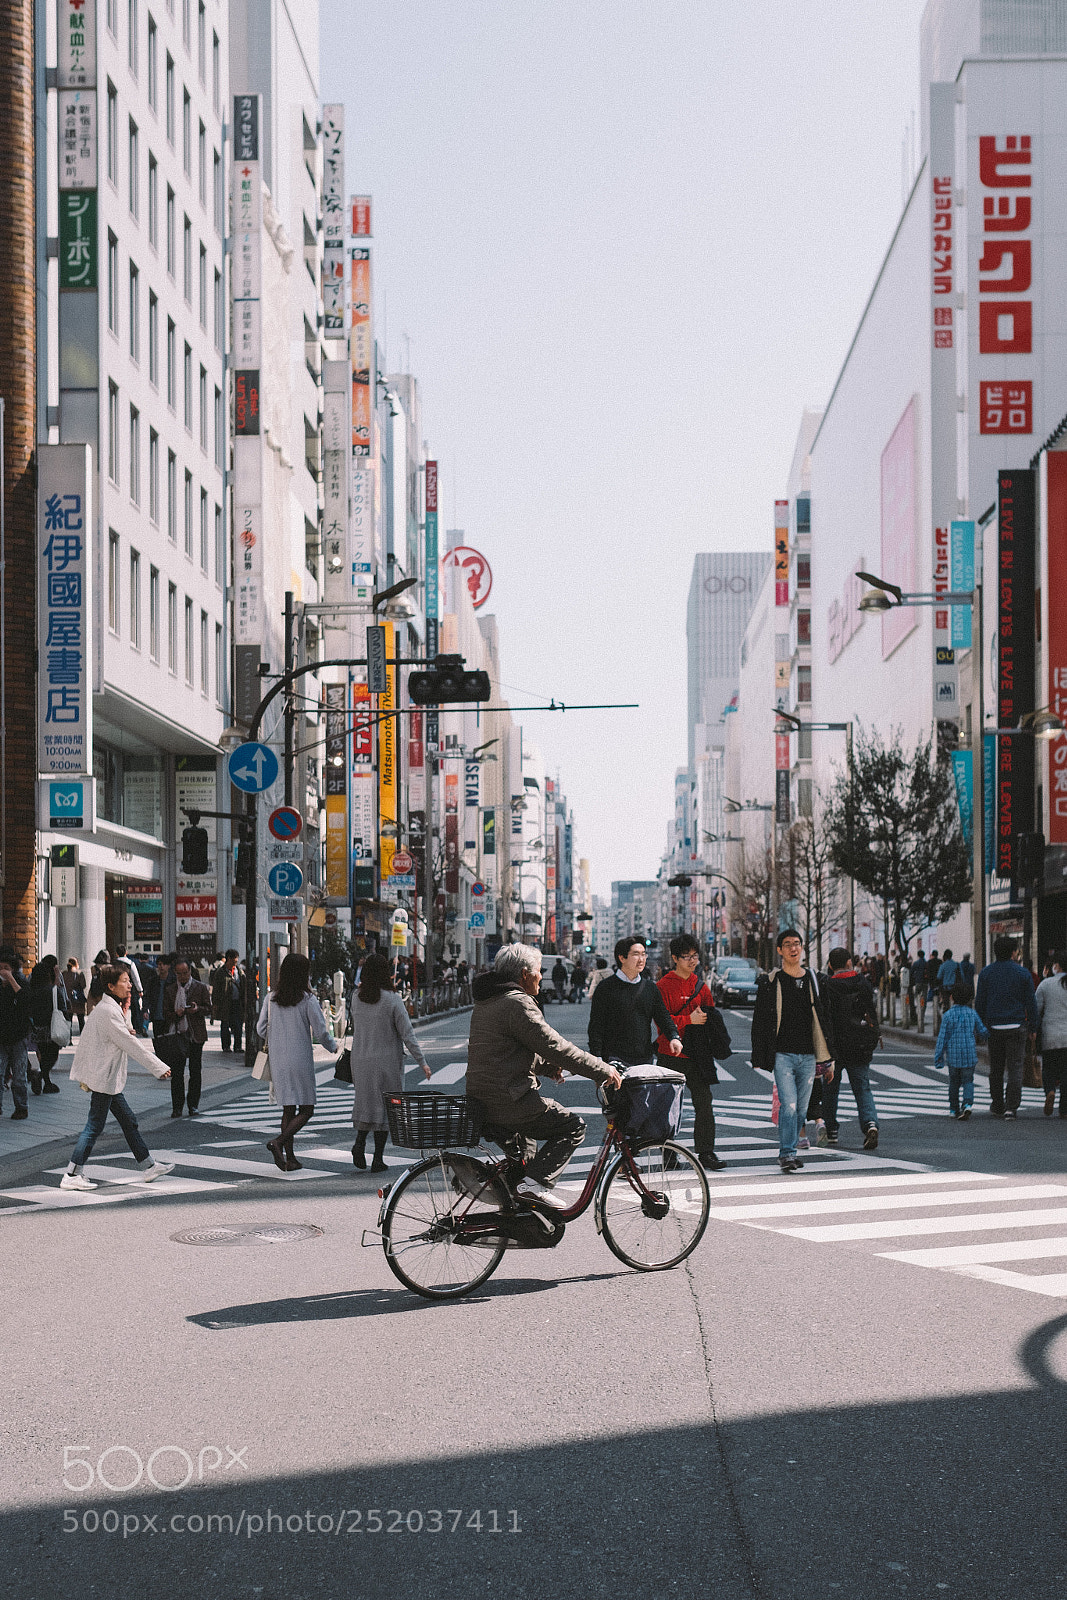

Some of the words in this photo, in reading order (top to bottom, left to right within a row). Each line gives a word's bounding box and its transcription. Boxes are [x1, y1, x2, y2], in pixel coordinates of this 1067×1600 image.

[978, 135, 1032, 354] ビックロ
[236, 376, 247, 429] union
[249, 387, 259, 417] disk
[42, 493, 83, 723] 紀伊國屋書店
[937, 651, 954, 662] GU
[355, 700, 371, 749] ガスト
[45, 746, 82, 756] 10:00AM
[50, 760, 82, 770] 9:00PM
[328, 780, 345, 792] 2F
[276, 870, 289, 892] P
[176, 902, 216, 912] 新宿皮フ科
